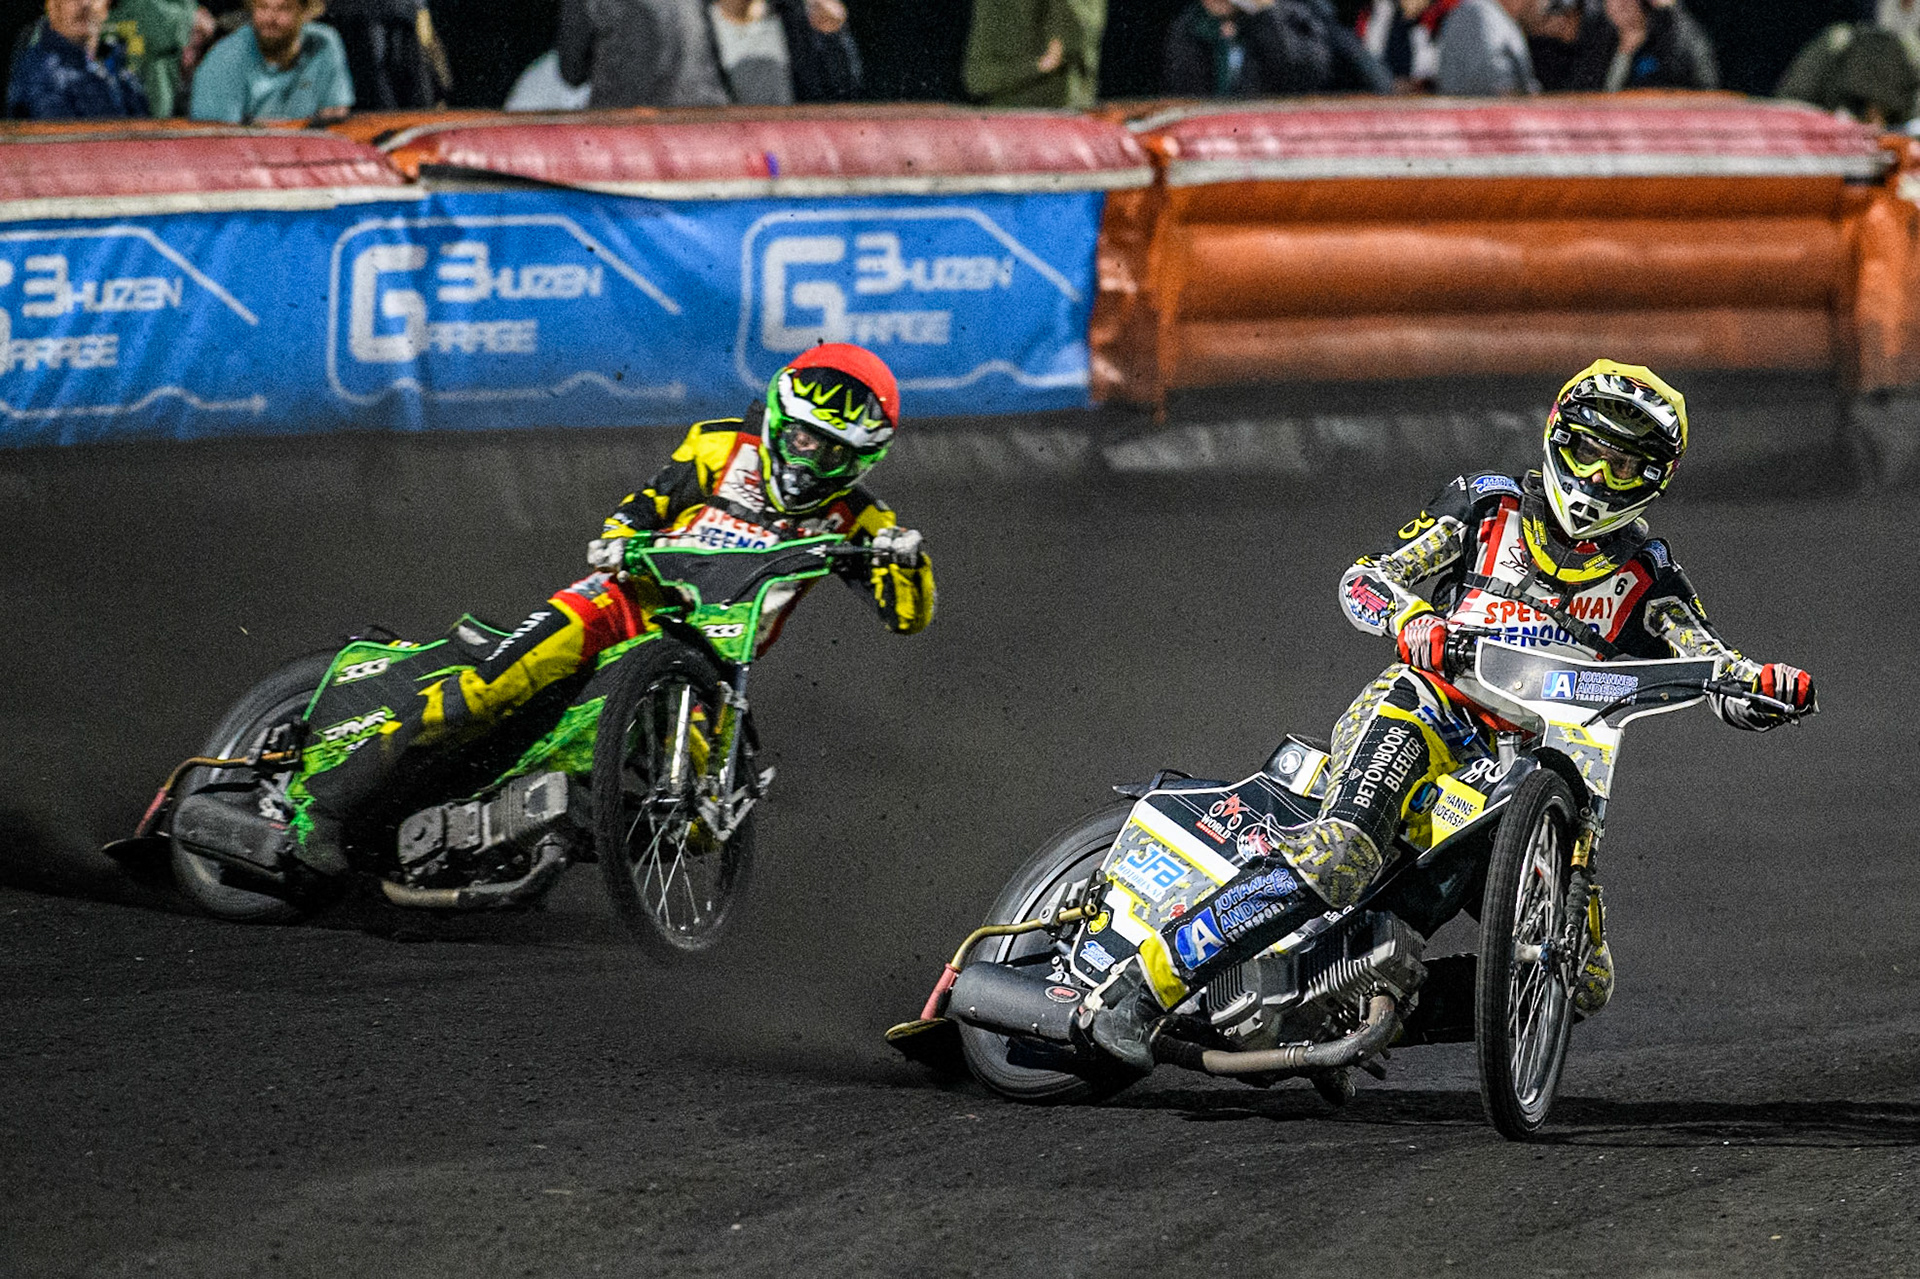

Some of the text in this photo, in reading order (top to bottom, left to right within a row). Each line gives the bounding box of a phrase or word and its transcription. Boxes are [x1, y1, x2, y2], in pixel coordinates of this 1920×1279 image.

[1614, 577, 1629, 597] 6
[1578, 671, 1639, 688] JOHANNES
[1353, 726, 1411, 809] BETONBOOR
[1384, 736, 1425, 793] BLEEKER
[1200, 812, 1232, 840] WORLD
[1214, 867, 1290, 918] JOHANNES
[1219, 875, 1299, 933] ANDERSEN
[1225, 902, 1286, 943] TRANSPORT
